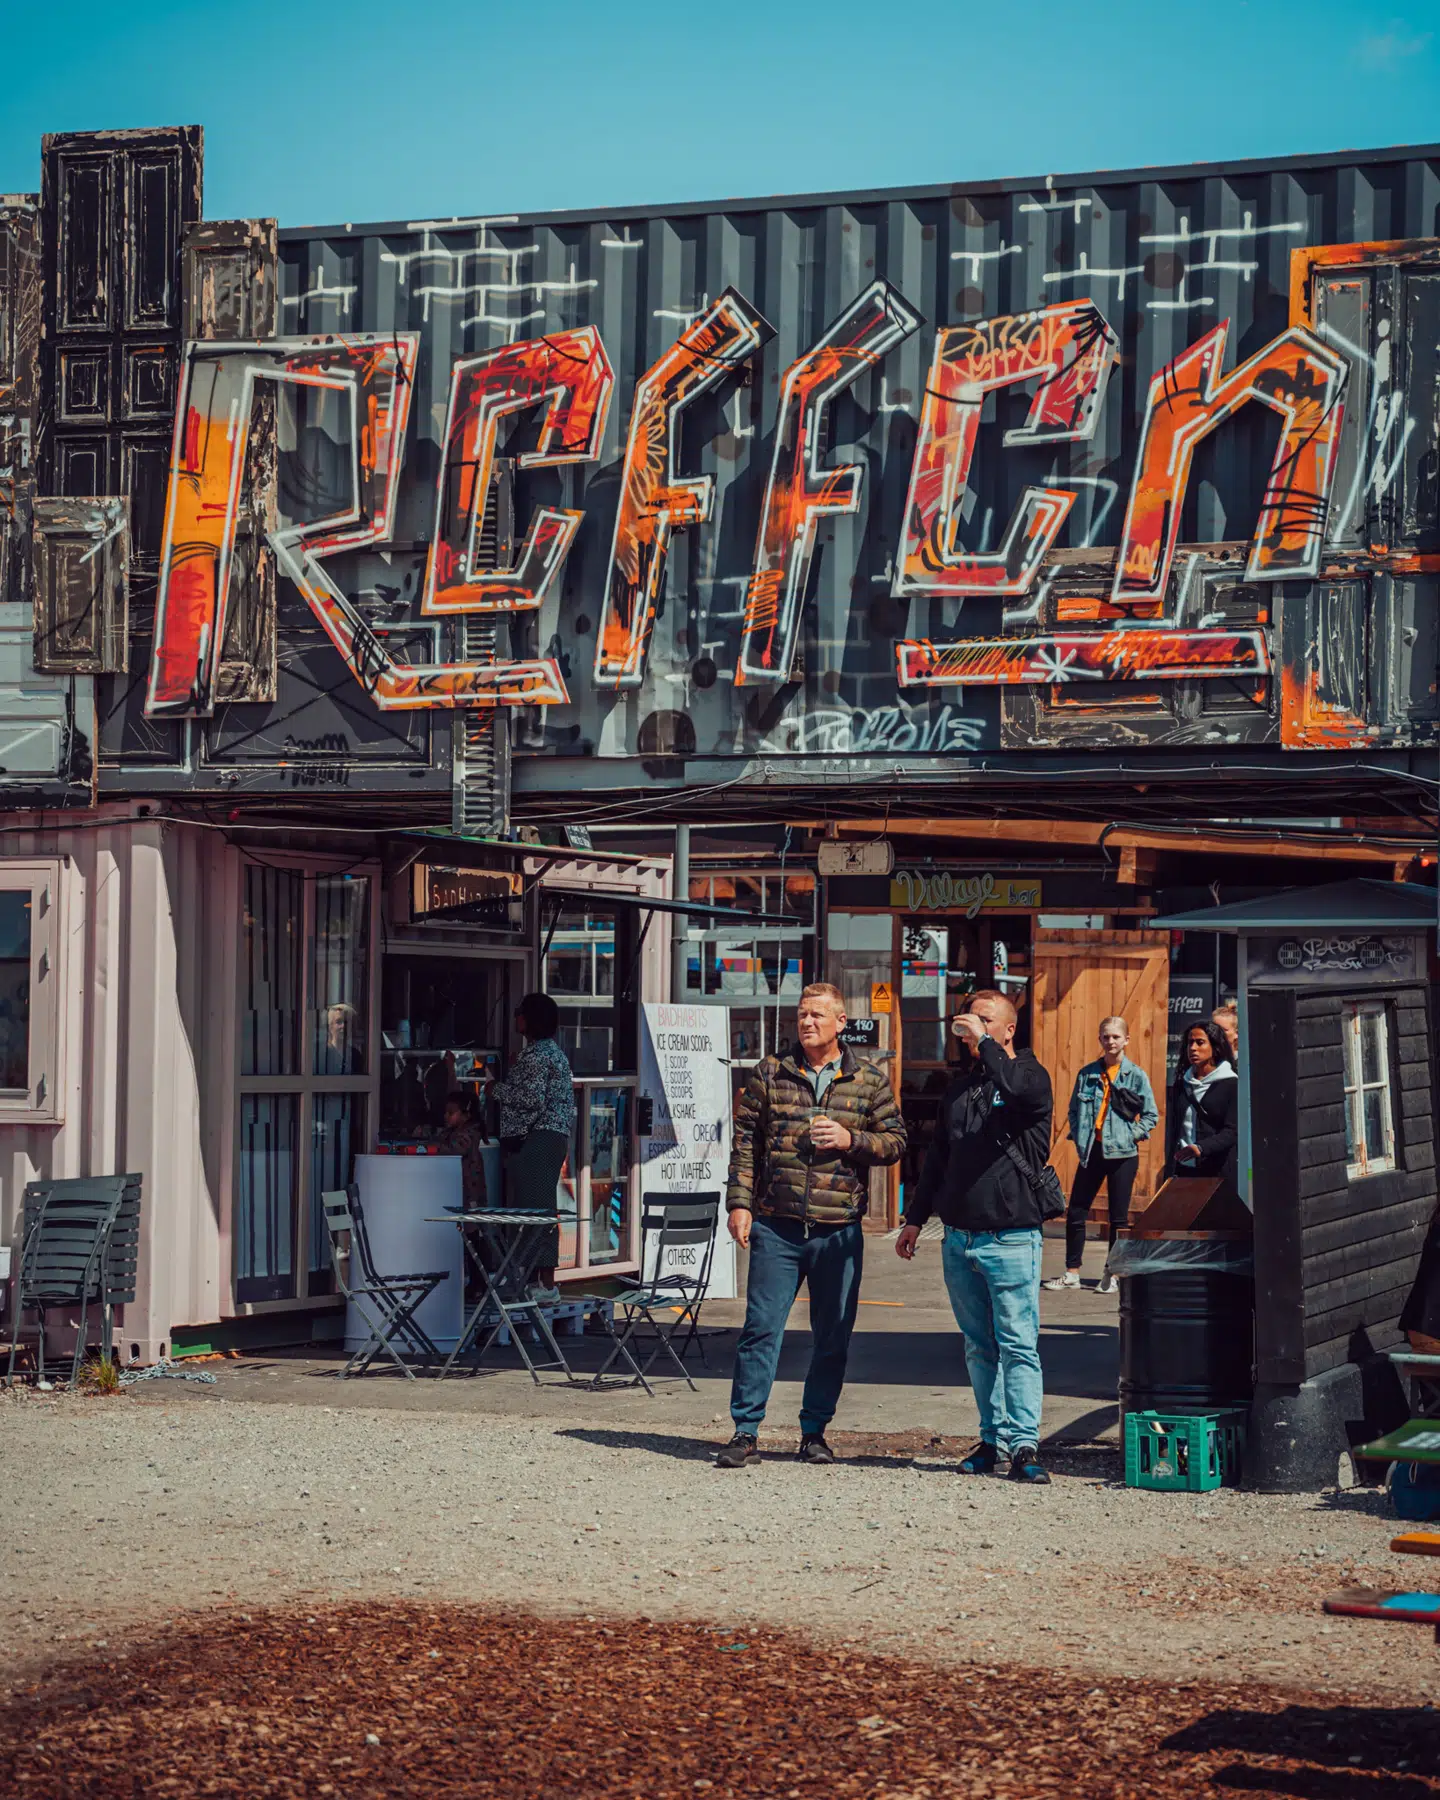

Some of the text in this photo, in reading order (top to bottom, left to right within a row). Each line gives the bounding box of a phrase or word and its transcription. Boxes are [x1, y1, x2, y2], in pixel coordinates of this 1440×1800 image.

[896, 869, 1039, 920] Village bar
[1167, 996, 1203, 1013] effen
[658, 1008, 708, 1027] BADHABITS
[854, 1018, 874, 1031] 180
[657, 1034, 666, 1050] ICE
[668, 1035, 690, 1051] CREAM
[670, 1056, 688, 1069] SCOOP
[669, 1071, 693, 1085] SCOOPS
[670, 1086, 693, 1099] SCOOPS
[658, 1103, 696, 1120] MILKSHAKE
[649, 1124, 684, 1142] ARAMEL
[693, 1124, 717, 1142] OREO
[648, 1143, 687, 1159] ESPRESSO
[660, 1162, 677, 1180] HOT
[667, 1247, 697, 1266] OTHERS
